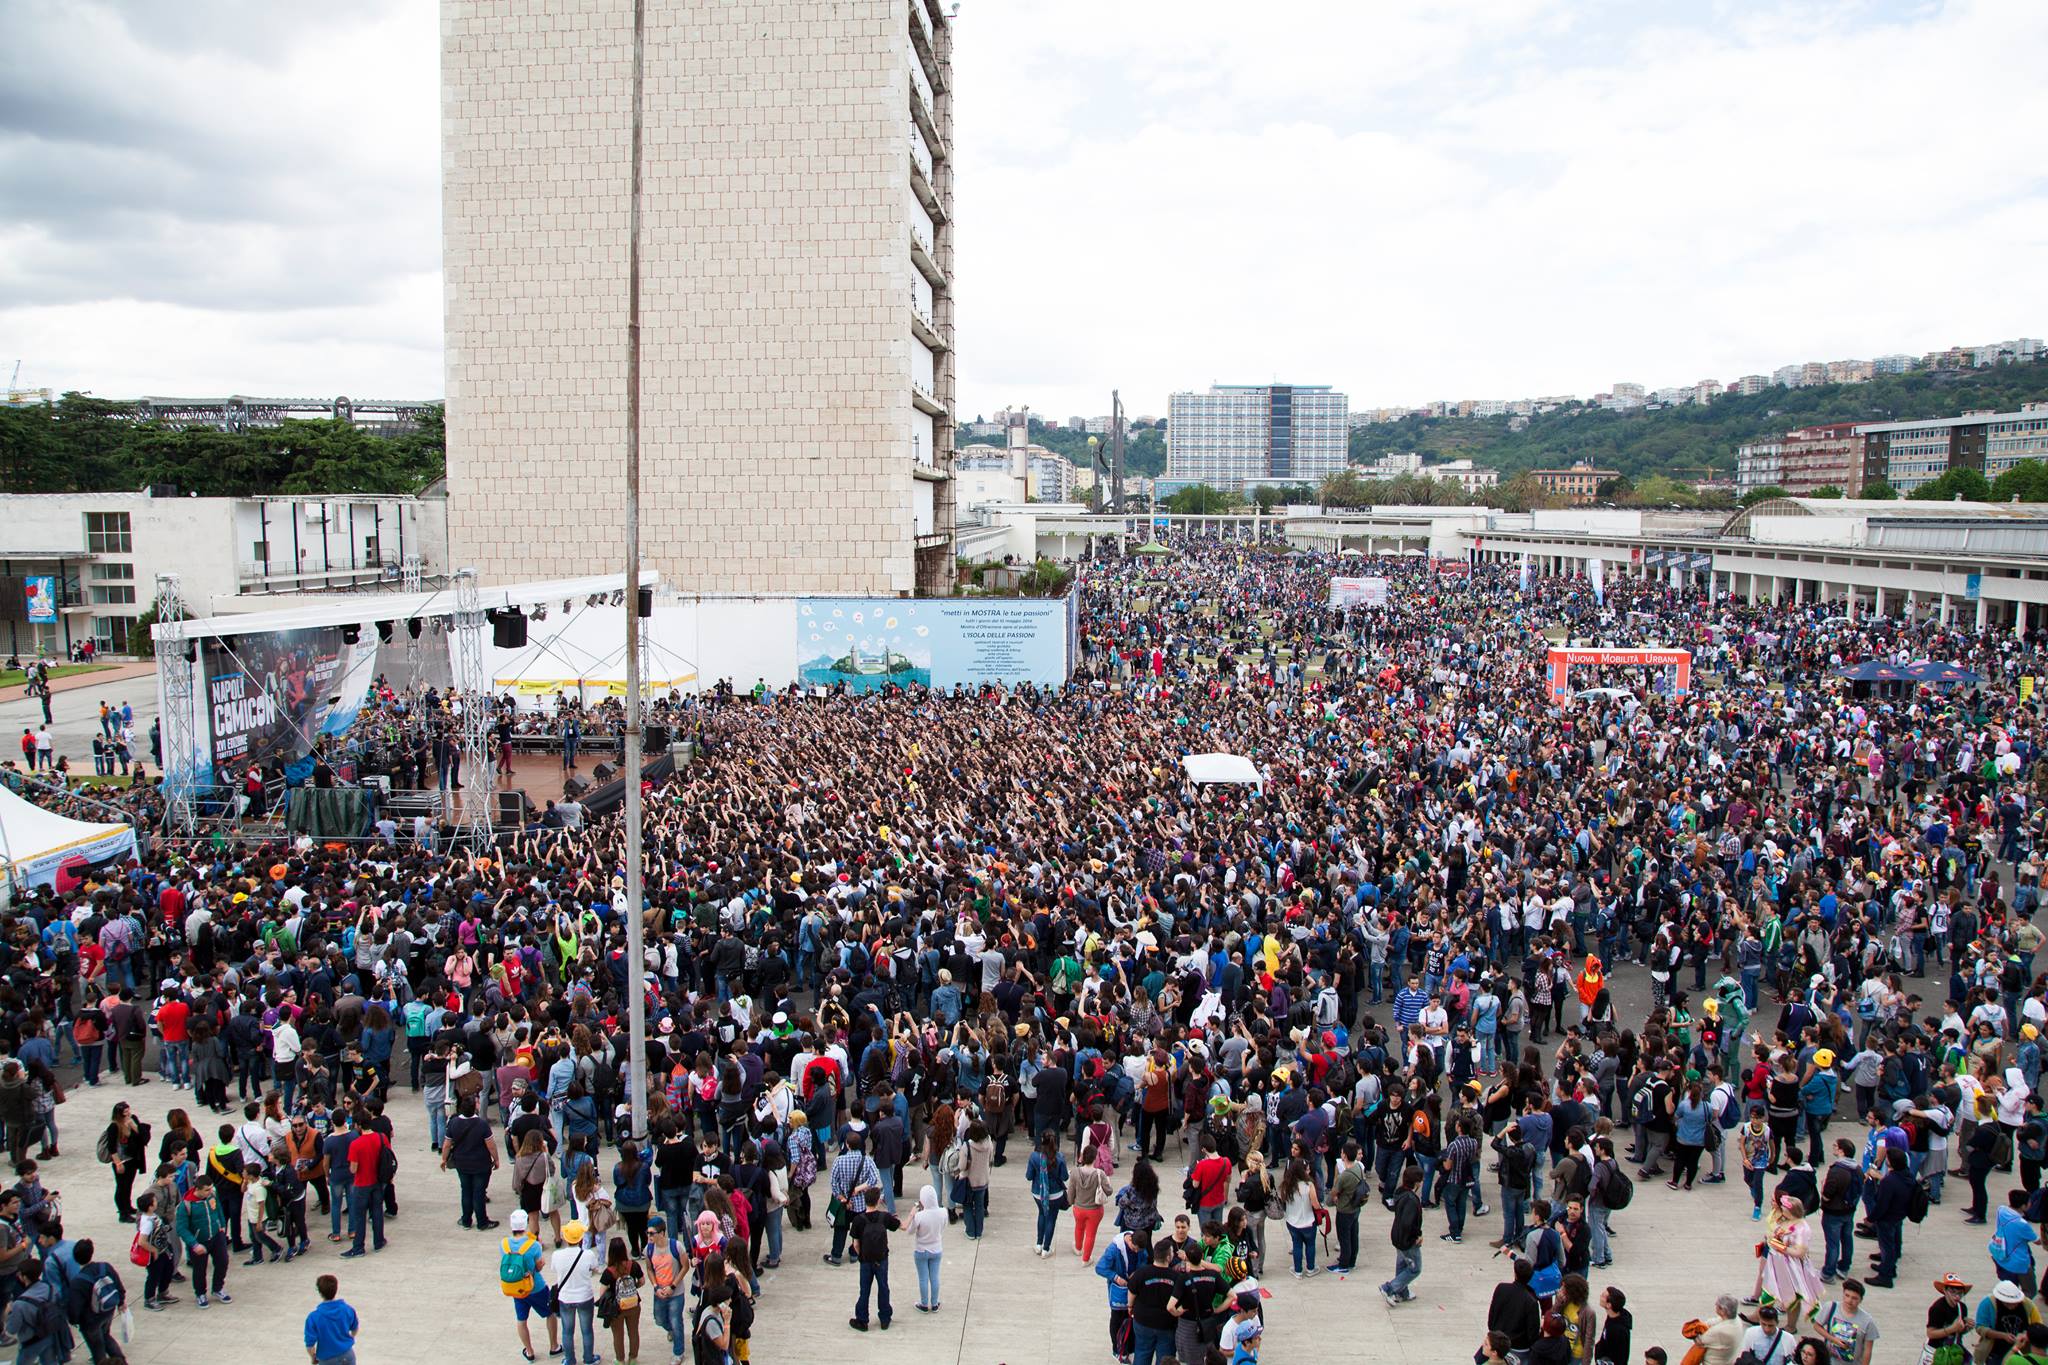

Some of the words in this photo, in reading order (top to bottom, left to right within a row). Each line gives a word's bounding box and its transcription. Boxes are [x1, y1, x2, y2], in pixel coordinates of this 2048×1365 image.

[1566, 653, 1595, 663] NUOVA
[1645, 653, 1678, 663] URBANA
[212, 677, 245, 704] NAPOLI
[214, 693, 275, 737] COMICON
